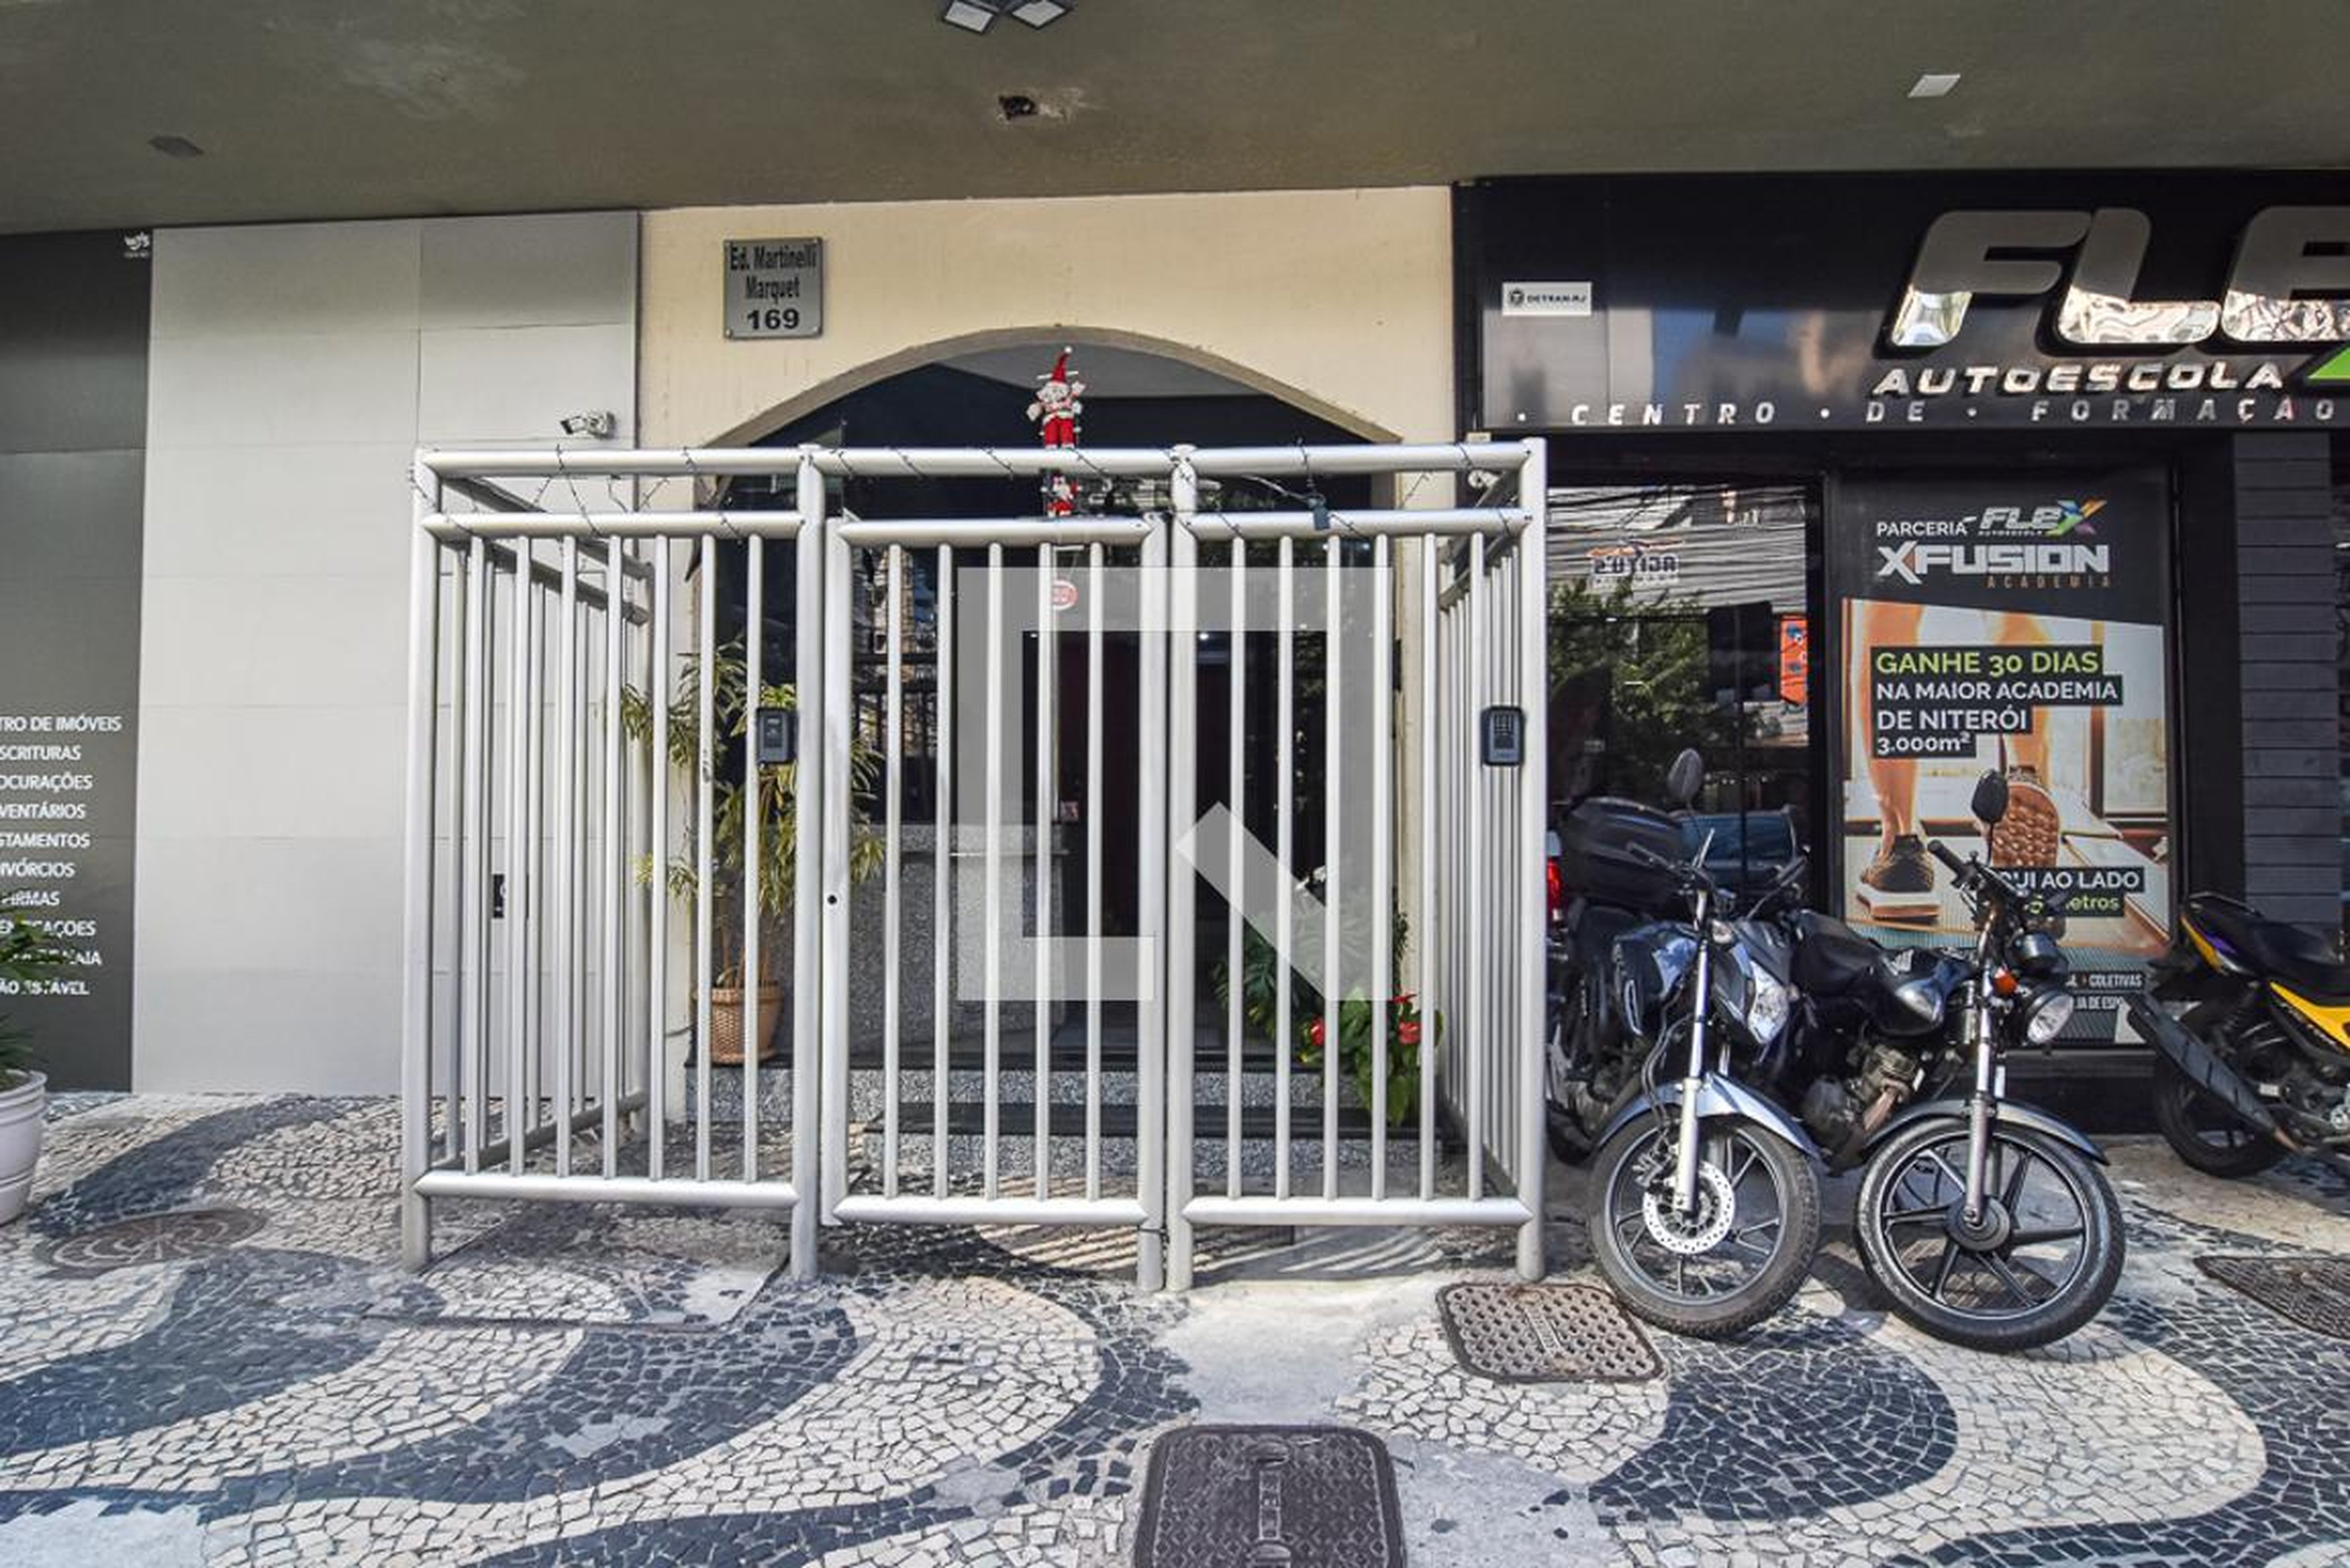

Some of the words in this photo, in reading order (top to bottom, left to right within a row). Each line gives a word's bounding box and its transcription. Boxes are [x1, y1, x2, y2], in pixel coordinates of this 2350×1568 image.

[731, 246, 750, 270] Ed.
[746, 275, 800, 305] Marquet
[1891, 207, 2350, 379] FLE
[747, 308, 800, 330] 169
[1873, 362, 2284, 395] AUTOESCOLA
[1571, 401, 1774, 425] CENTRO
[1866, 400, 1926, 422] DE
[1876, 521, 1968, 537] PARCERIA
[1878, 540, 2109, 584] XFUSION
[1877, 652, 1980, 674] GANHE
[1989, 655, 2023, 677] 30
[2032, 651, 2099, 673] DIAS
[1877, 683, 1910, 700] NA
[1915, 682, 1991, 699] MAIOR
[1996, 681, 2118, 700] ACADEMIA
[31, 717, 52, 731] DE
[56, 714, 122, 731] IMÓVEIS
[1877, 711, 1912, 731] DE
[1919, 705, 2027, 731] NITERÓI
[2040, 871, 2073, 888] AO
[2079, 871, 2140, 888] LADO
[2066, 895, 2120, 909] etros
